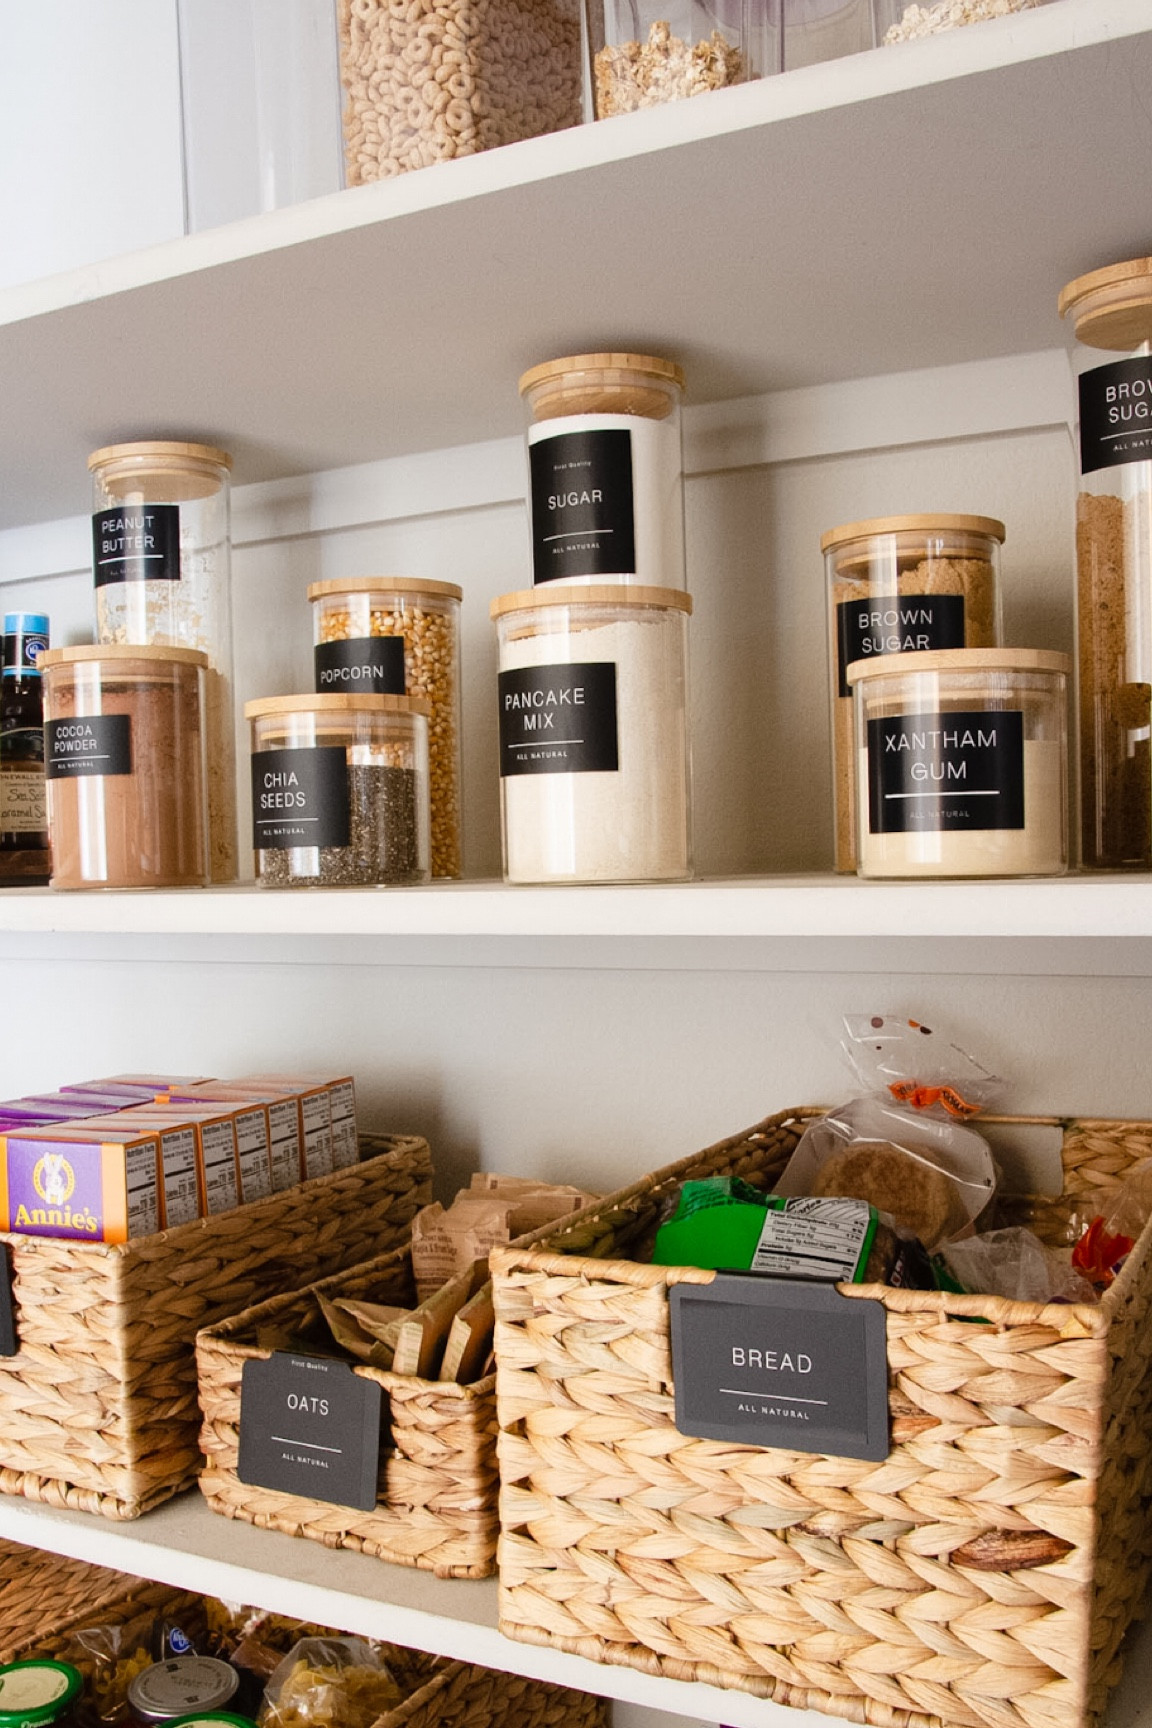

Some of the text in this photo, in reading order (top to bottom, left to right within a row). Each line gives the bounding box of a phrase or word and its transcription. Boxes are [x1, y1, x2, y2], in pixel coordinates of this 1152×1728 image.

[1105, 379, 1152, 403] BRO
[1108, 401, 1152, 424] SUG
[1131, 439, 1152, 448] NAT
[547, 489, 603, 511] SUGAR
[101, 515, 155, 534] PEANUT
[102, 535, 156, 554] BUTTER
[566, 542, 601, 551] NATURAL
[858, 609, 933, 630] BROWN
[861, 634, 930, 654] SUGAR
[320, 665, 384, 684] POPCORN
[504, 687, 586, 711] PANCAKE
[523, 712, 555, 731] MIX
[56, 725, 93, 740] COCOA
[885, 729, 998, 753] XANTHAM
[54, 739, 97, 753] POWDER
[530, 750, 568, 759] NATURAL
[263, 771, 299, 788] CHIA
[910, 761, 968, 781] GUM
[260, 791, 306, 809] SEEDS
[273, 827, 305, 835] NATURAL
[15, 1203, 98, 1234] Annie's
[731, 1346, 812, 1374] BREAD
[286, 1393, 329, 1416] OATS
[738, 1404, 810, 1420] ALL NATURAL
[281, 1453, 329, 1468] ALL NATURAL
